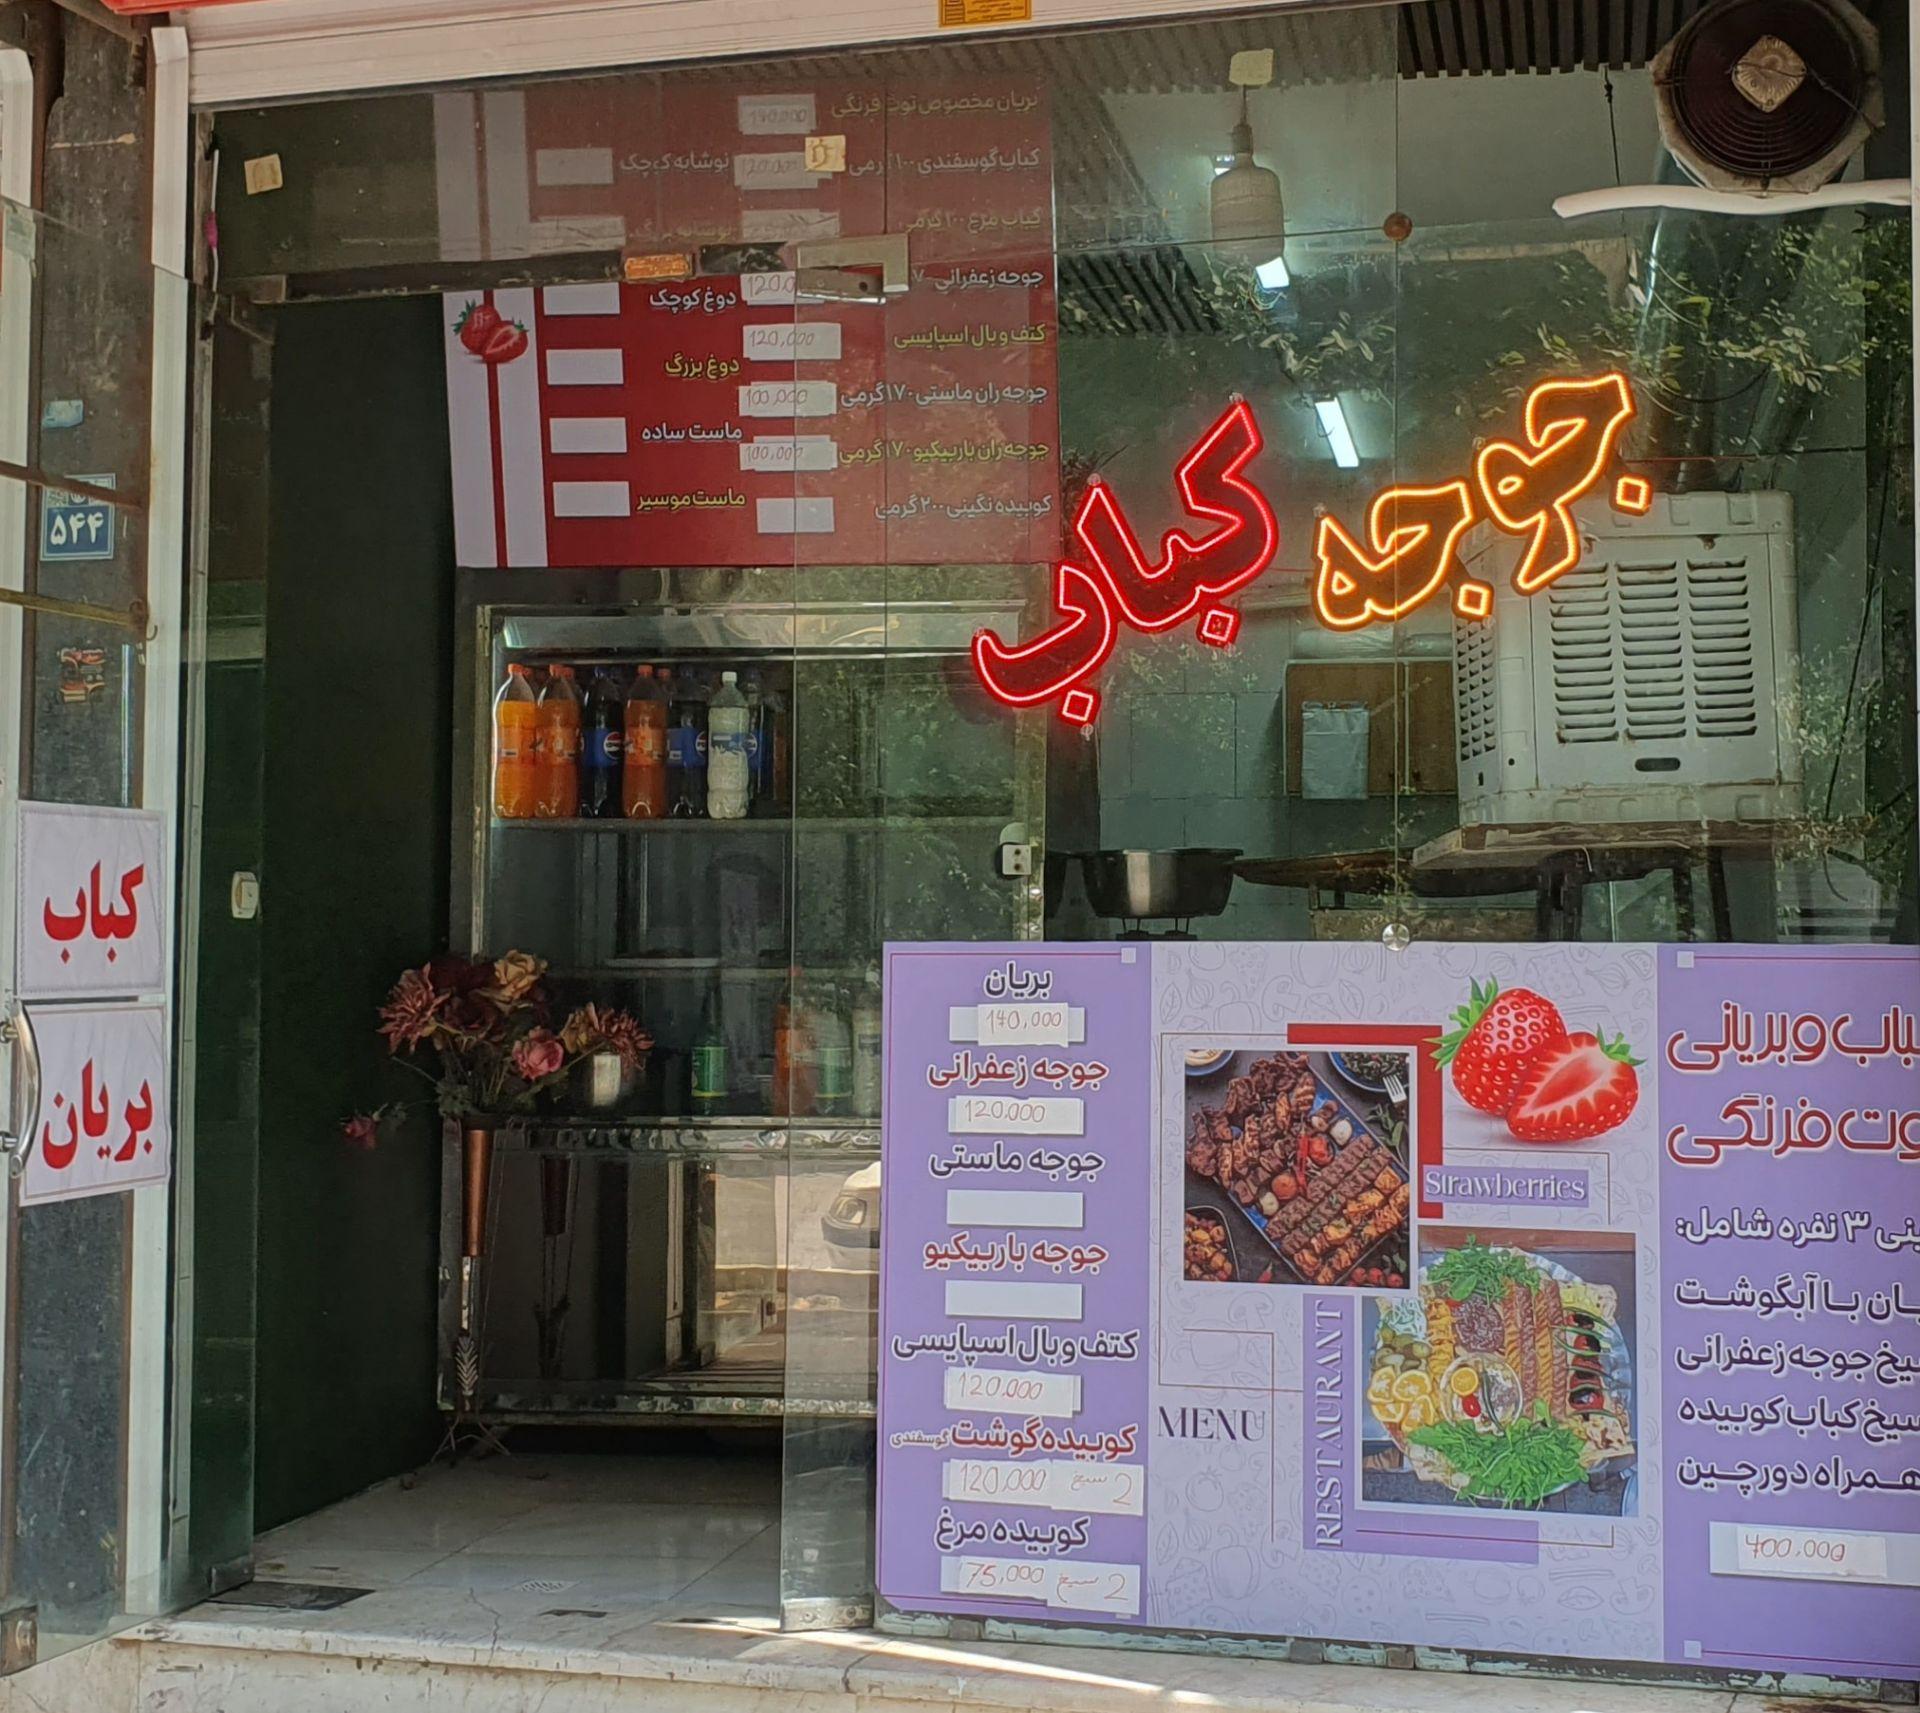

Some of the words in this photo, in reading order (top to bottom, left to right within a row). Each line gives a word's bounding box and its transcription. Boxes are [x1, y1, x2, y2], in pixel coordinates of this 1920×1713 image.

[831, 91, 884, 119] فرنگی
[919, 94, 995, 117] مخصوص
[672, 146, 731, 175] نوشابه
[917, 147, 1000, 176] گوسفندی
[1001, 146, 1041, 169] کباب
[967, 211, 1001, 235] مرغ
[1003, 207, 1043, 229] کباب
[933, 266, 996, 292] زعفرانی
[649, 287, 702, 315] کوچک
[702, 285, 737, 314] دوغ
[893, 324, 969, 352] اسپایسی
[970, 323, 998, 348] بال
[1010, 322, 1047, 343] کتف
[664, 352, 705, 379] بزرگ
[705, 352, 741, 380] دوغ
[839, 382, 886, 409] گرمی
[914, 381, 973, 408] ماستی
[974, 381, 1001, 405] ران
[1001, 383, 1048, 406] جوجه
[640, 421, 687, 442] ساده
[688, 420, 744, 442] ماست
[838, 440, 884, 466] گرمی
[912, 440, 976, 466] باربیکیو
[976, 440, 1003, 464] ران
[1003, 442, 1050, 464] جوجه
[636, 490, 692, 511] موسیر
[691, 487, 746, 507] ماست
[874, 494, 920, 522] گرمی
[945, 494, 995, 521] نگینی
[995, 494, 1053, 519] کوبیده
[1317, 372, 1652, 630] جوجه
[50, 511, 104, 546] ۵۴۴
[972, 395, 1280, 726] کباب
[43, 858, 145, 965] کباب
[984, 960, 1052, 998] بریان
[1665, 999, 1789, 1074] بریانی
[1830, 1004, 1920, 1068] باب
[926, 1051, 1029, 1090] زعفرانی
[1031, 1056, 1110, 1090] جوجه
[42, 1057, 154, 1171] بریان
[1665, 1091, 1834, 1168] فرنگی
[1836, 1107, 1920, 1162] وت
[928, 1141, 1024, 1179] ماستی
[1028, 1146, 1104, 1181] جوجه
[1425, 1169, 1587, 1201] Strawberries
[1675, 1204, 1774, 1247] شامل:
[1777, 1211, 1840, 1248] نفره
[1841, 1209, 1872, 1244] ۳
[923, 1231, 1027, 1272] باربیکیو
[1031, 1237, 1109, 1275] جوجه
[1673, 1271, 1820, 1322] آبگوشت
[1820, 1279, 1861, 1323] با
[893, 1322, 1016, 1368] اسپایسی
[1016, 1325, 1060, 1367] بال
[1078, 1328, 1141, 1361] کتف
[1674, 1332, 1788, 1375] زعفرانی
[1786, 1343, 1874, 1382] جوجه
[1157, 1405, 1267, 1442] MENU
[1314, 1299, 1343, 1548] RESTAURANT
[1677, 1395, 1786, 1433] کوبیده
[1783, 1394, 1863, 1439] کباب
[891, 1430, 950, 1451] گوسفندی
[951, 1416, 1044, 1457] گوشت
[1039, 1422, 1139, 1462] کوبیده
[1111, 1471, 1133, 1506] 2
[1676, 1456, 1811, 1498] دورچین
[934, 1506, 988, 1551] مرغ
[990, 1516, 1092, 1553] کوبیده
[1103, 1572, 1129, 1602] 2
